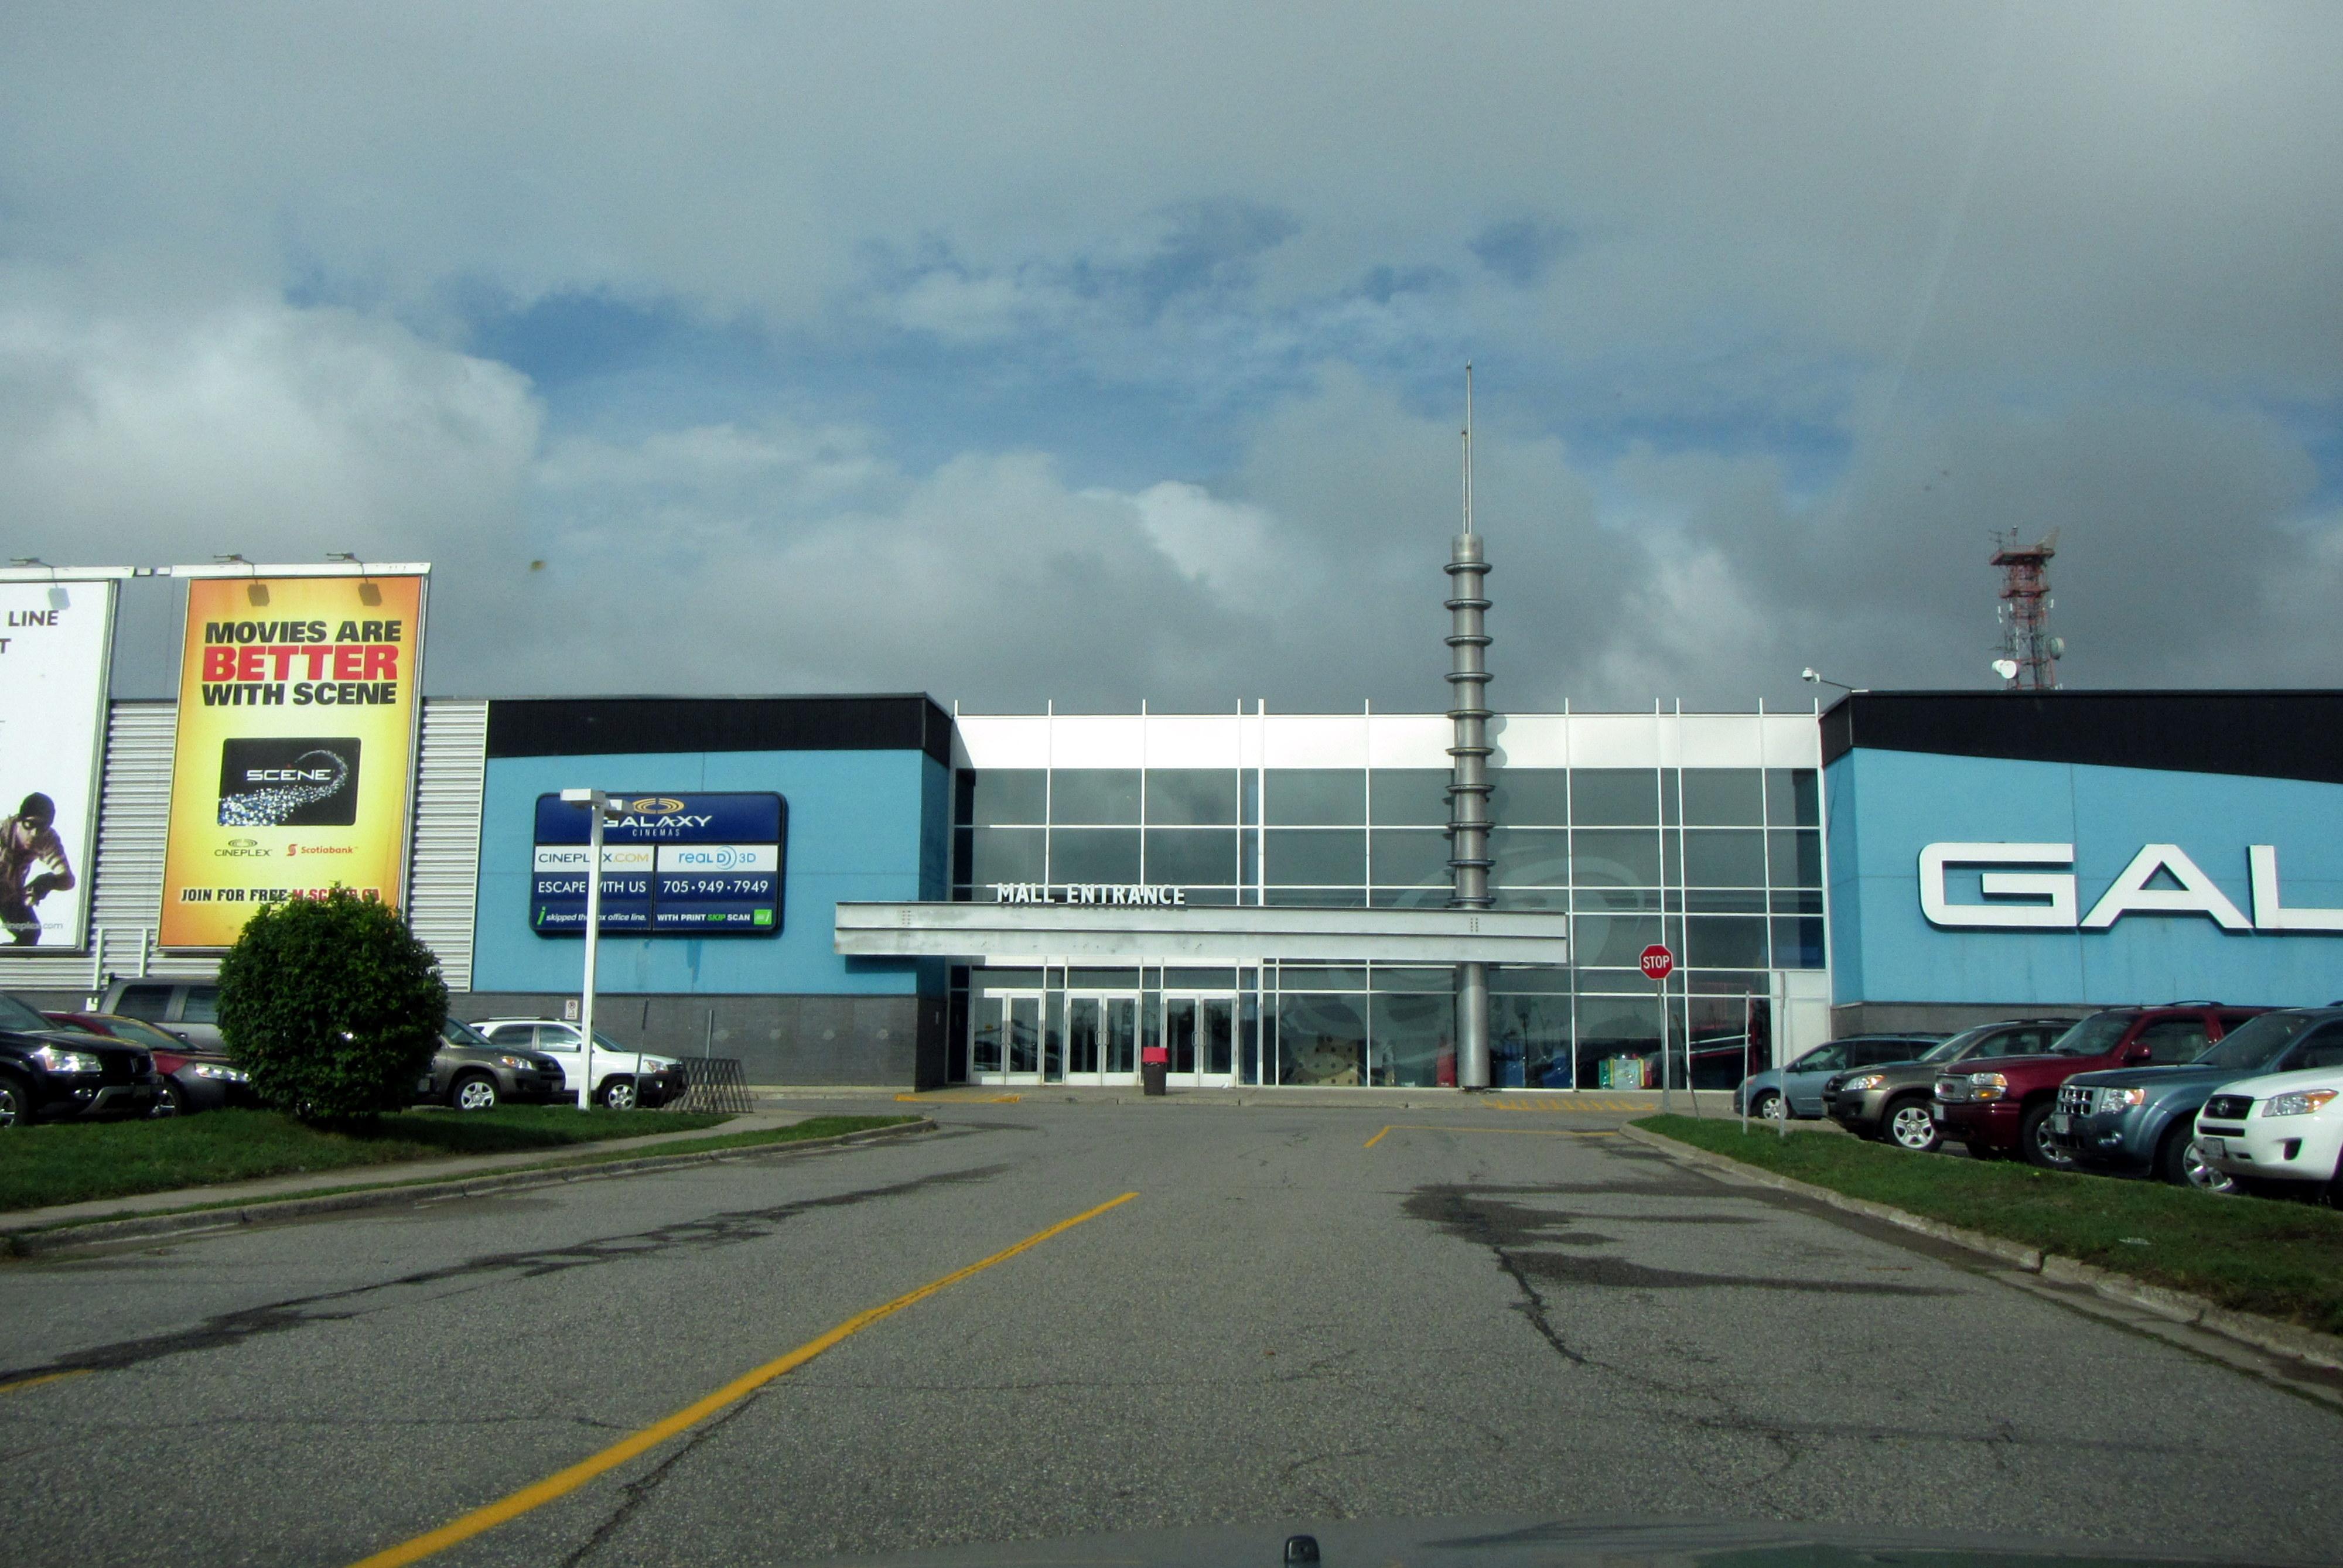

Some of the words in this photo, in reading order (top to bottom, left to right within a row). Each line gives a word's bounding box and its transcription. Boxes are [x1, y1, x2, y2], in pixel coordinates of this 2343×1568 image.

[8, 610, 59, 627] LINE
[205, 621, 327, 644] MOVIES
[335, 620, 402, 642] ARE
[202, 645, 399, 681] BETTER
[202, 683, 285, 706] WITH
[292, 682, 397, 705] SCENE
[246, 769, 331, 781] SCENE
[214, 849, 270, 857] CINEPLEX
[538, 853, 648, 863] CINEPLX.COM
[739, 853, 756, 863] 3D
[538, 881, 586, 893] ESCAPE
[629, 881, 646, 893] US
[1919, 842, 2343, 930] GAL
[181, 889, 212, 901] JOIN
[217, 889, 245, 901] FOR
[250, 889, 288, 901] FREE
[997, 883, 1054, 903] MALL
[1067, 883, 1185, 904] ENTRANCE
[546, 914, 578, 923] skipped
[1643, 955, 1669, 969] STOP
